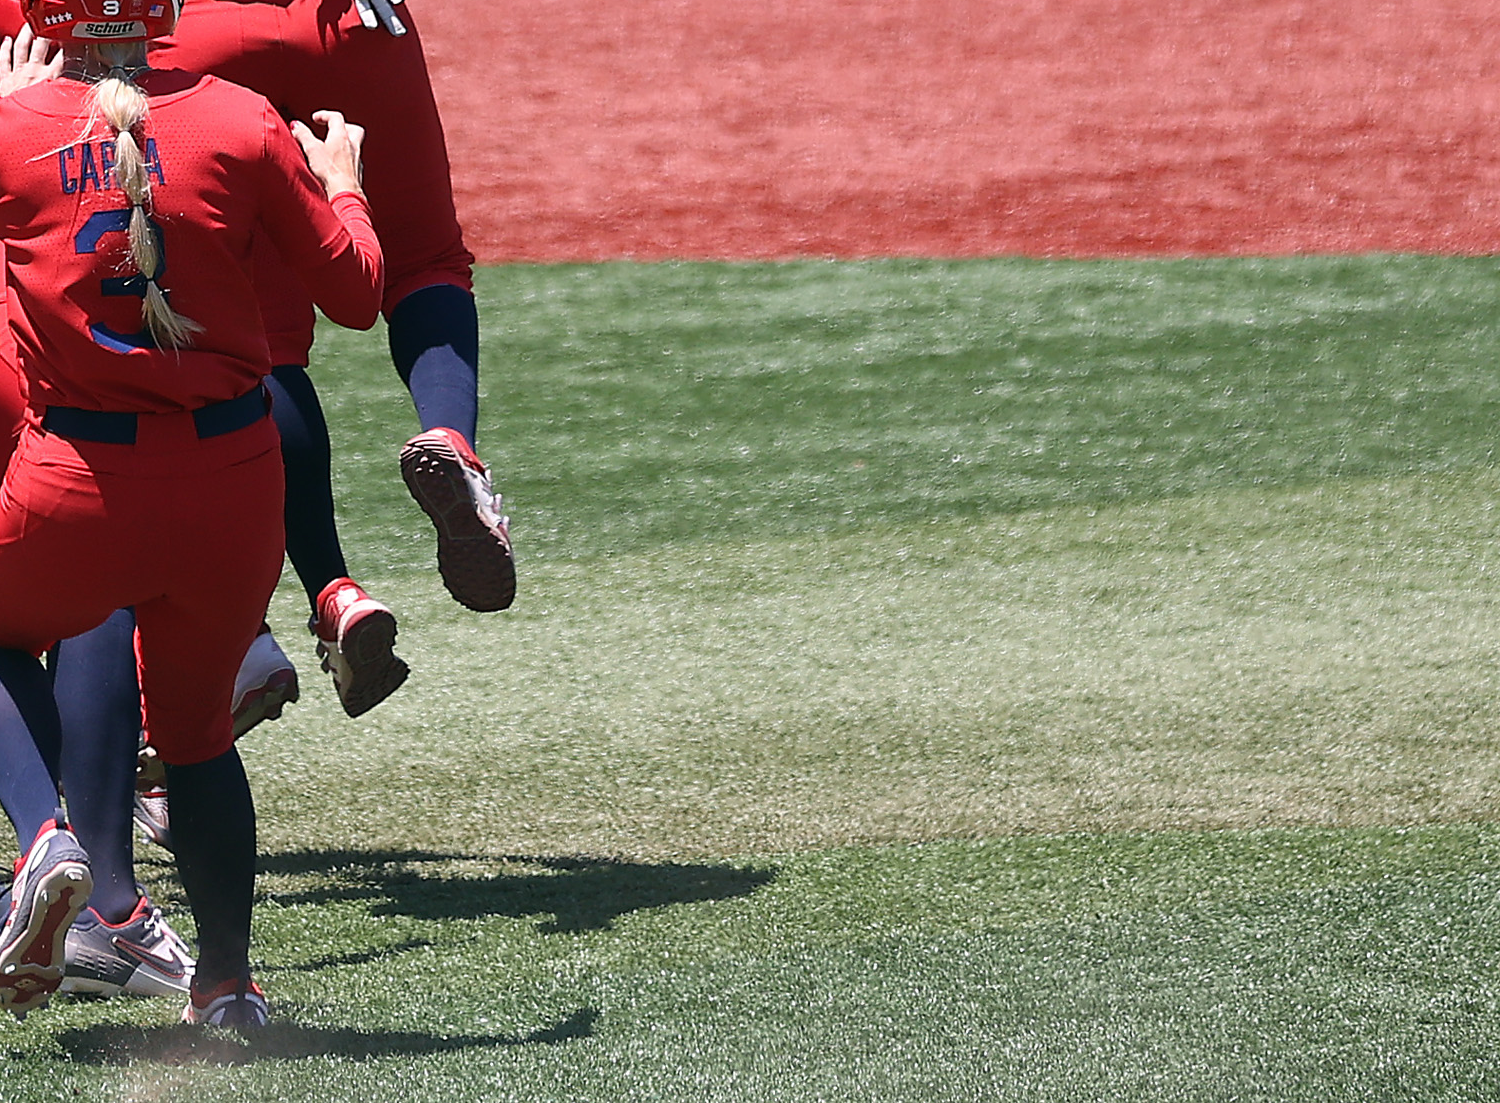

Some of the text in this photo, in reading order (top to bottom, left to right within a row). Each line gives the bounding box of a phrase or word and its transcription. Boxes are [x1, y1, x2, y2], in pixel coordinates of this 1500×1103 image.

[102, 0, 120, 16] 3
[59, 138, 165, 194] CARA
[74, 208, 171, 354] 3
